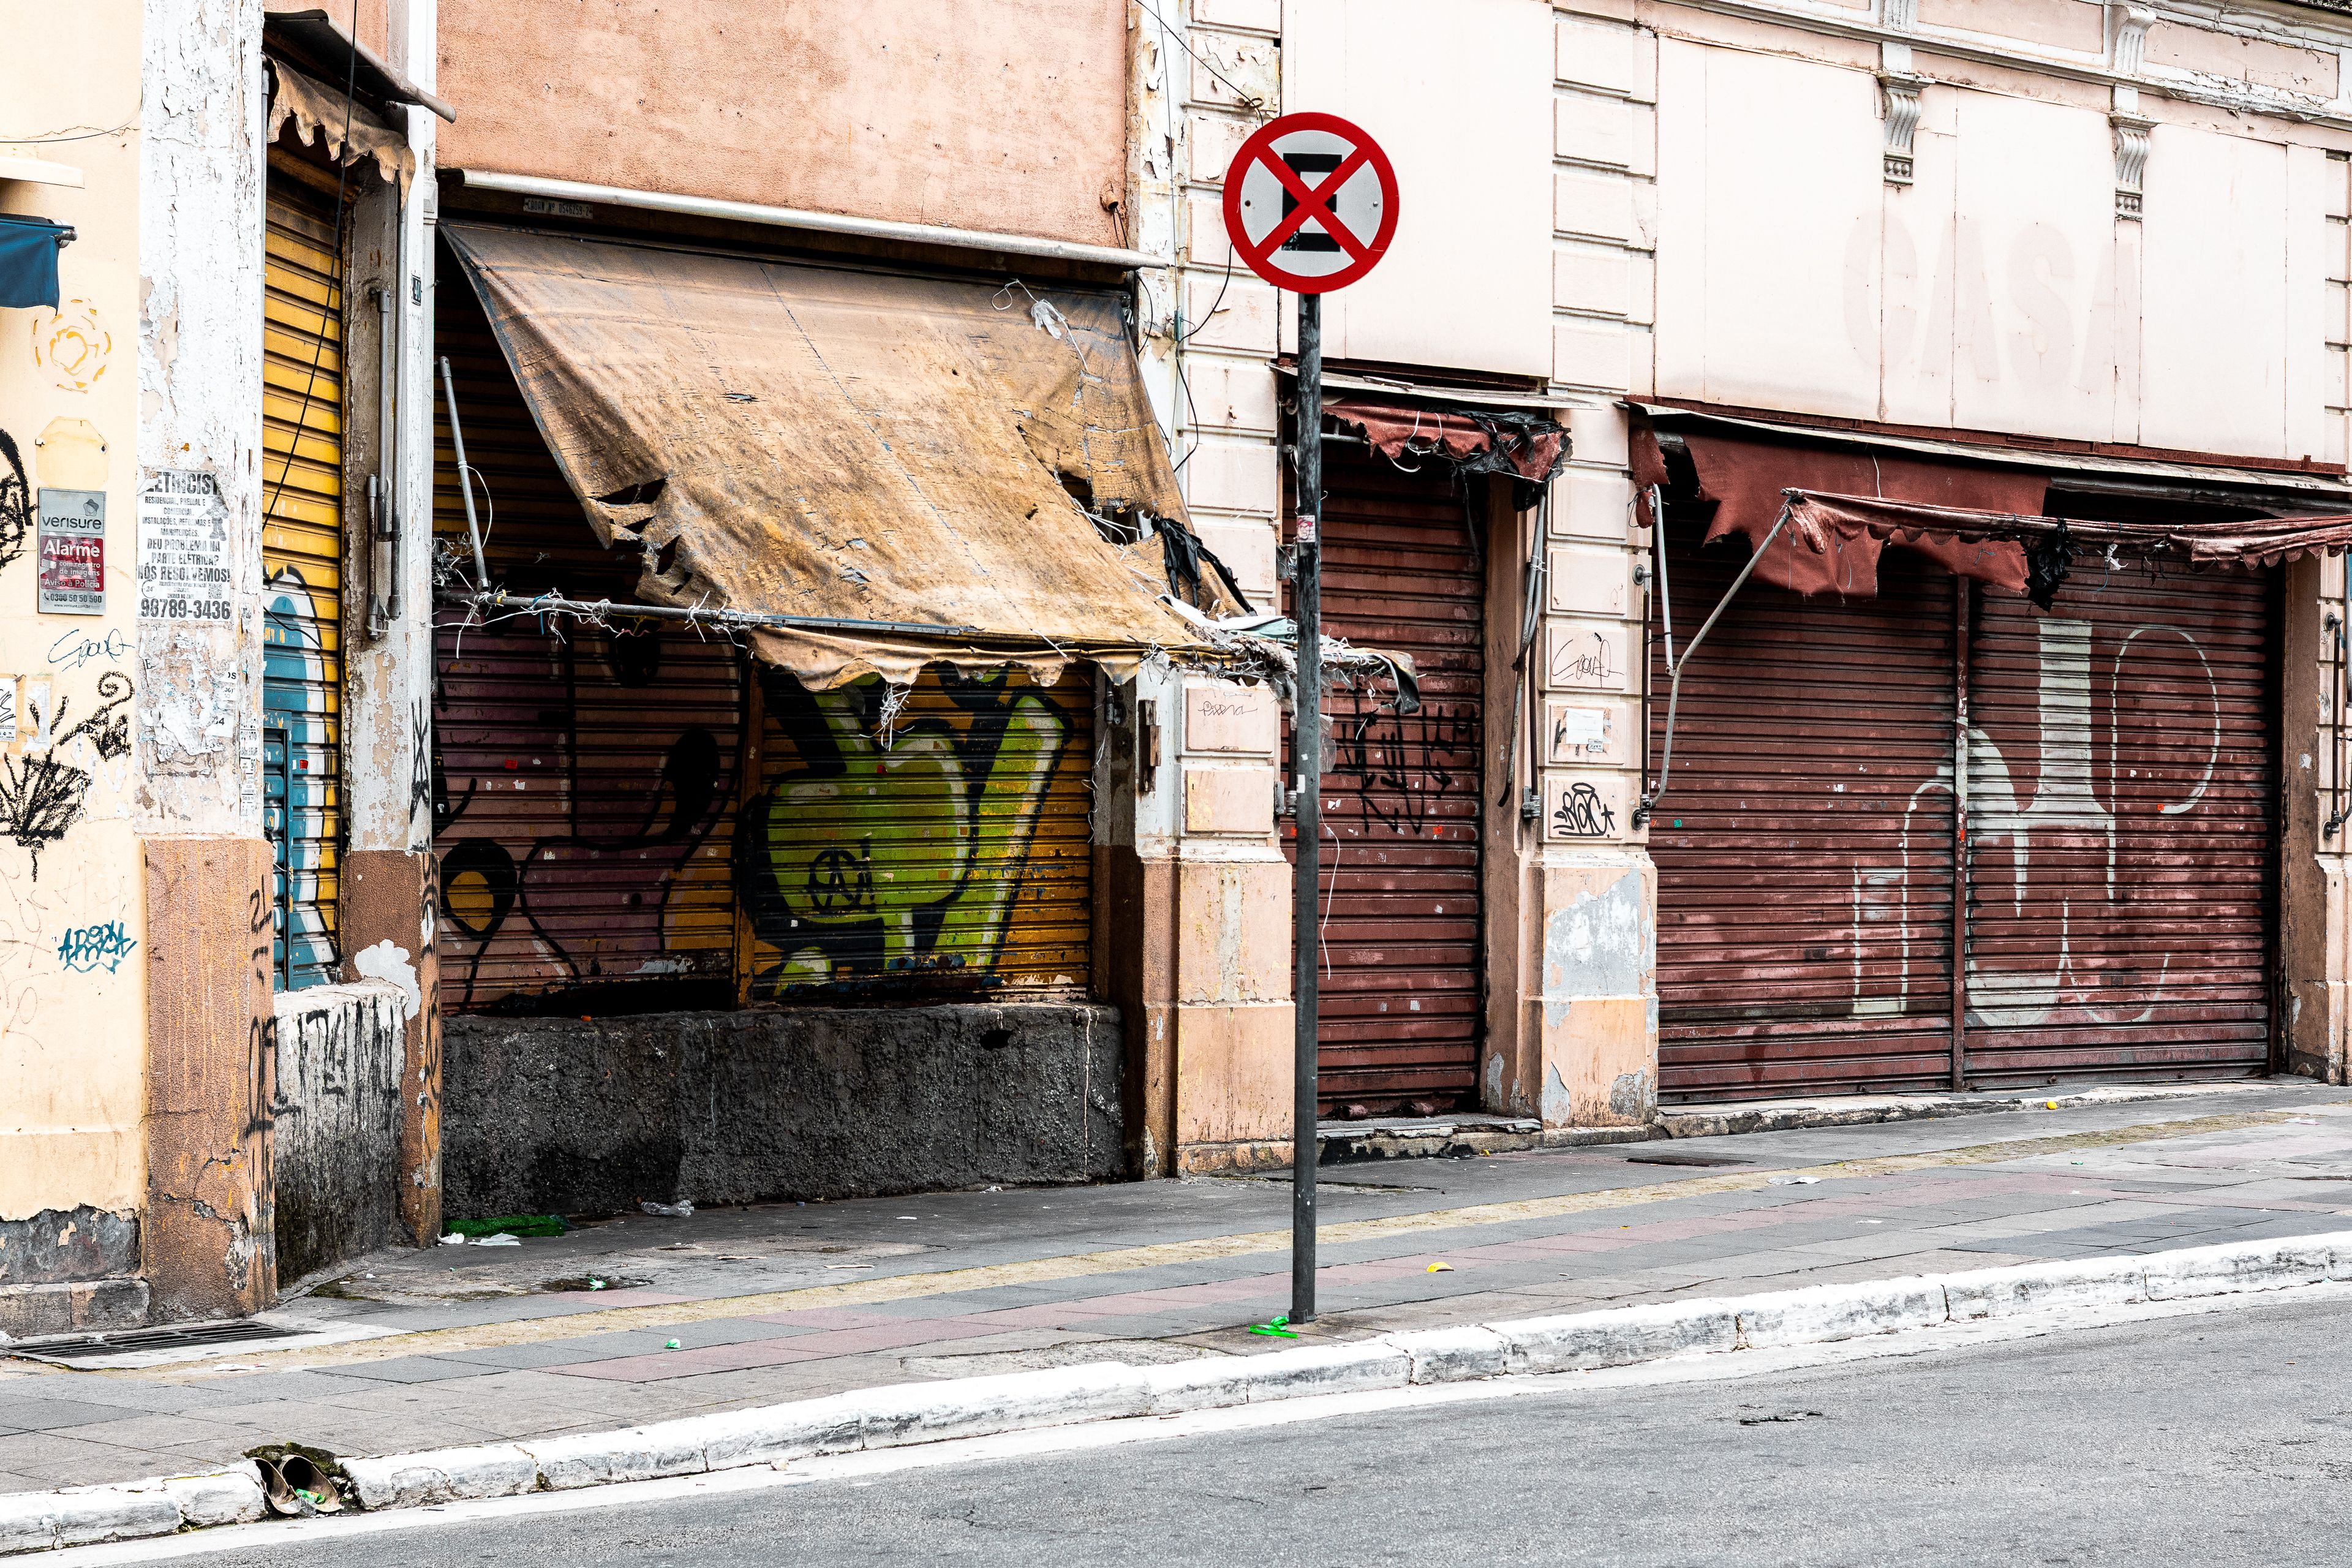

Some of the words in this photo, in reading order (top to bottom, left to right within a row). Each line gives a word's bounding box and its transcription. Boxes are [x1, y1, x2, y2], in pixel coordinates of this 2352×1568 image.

[1843, 207, 2149, 402] CASA
[42, 516, 102, 529] verisure
[43, 539, 100, 557] Alarme
[147, 538, 162, 549] DEU
[164, 539, 207, 551] PROBLEMA
[209, 541, 221, 552] NA
[151, 552, 176, 564] PARTE
[138, 562, 157, 580] NÓS
[160, 566, 230, 582] RESOLVEMOS!
[141, 598, 230, 619] 98789-3436
